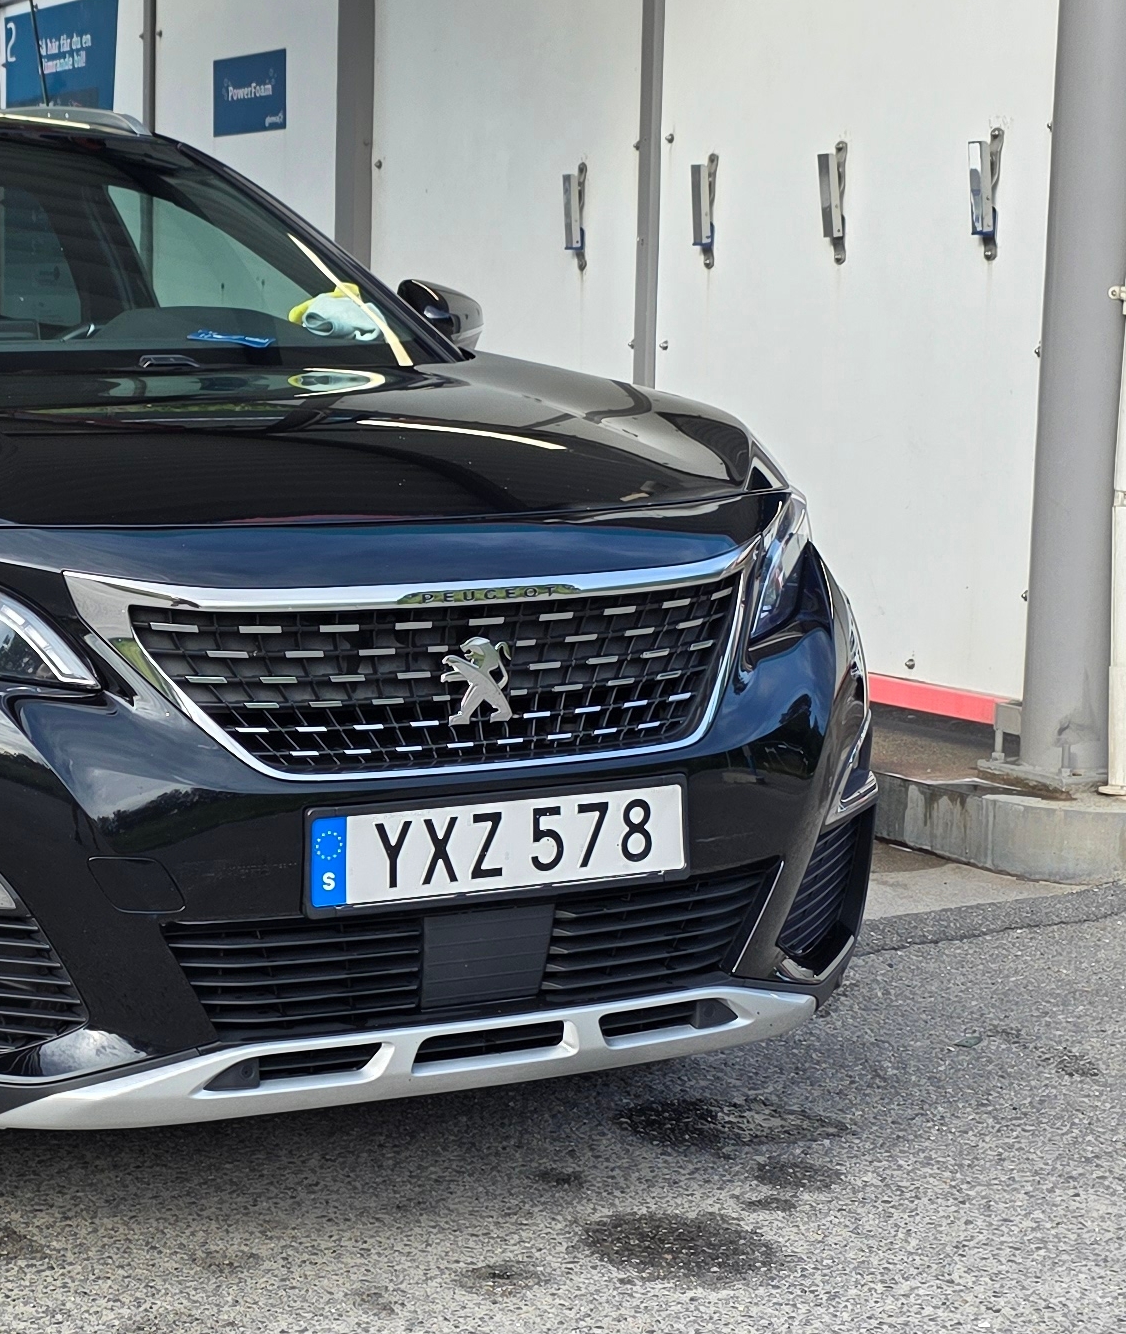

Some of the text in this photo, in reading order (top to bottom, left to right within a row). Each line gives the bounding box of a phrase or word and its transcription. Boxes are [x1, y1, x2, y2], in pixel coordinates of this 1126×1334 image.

[7, 22, 16, 62] 2
[72, 33, 81, 49] du
[82, 34, 92, 47] en
[228, 82, 272, 101] PowerFoam
[421, 586, 557, 604] PEUGEOT
[375, 798, 653, 888] YXZ 578
[322, 872, 335, 890] S
